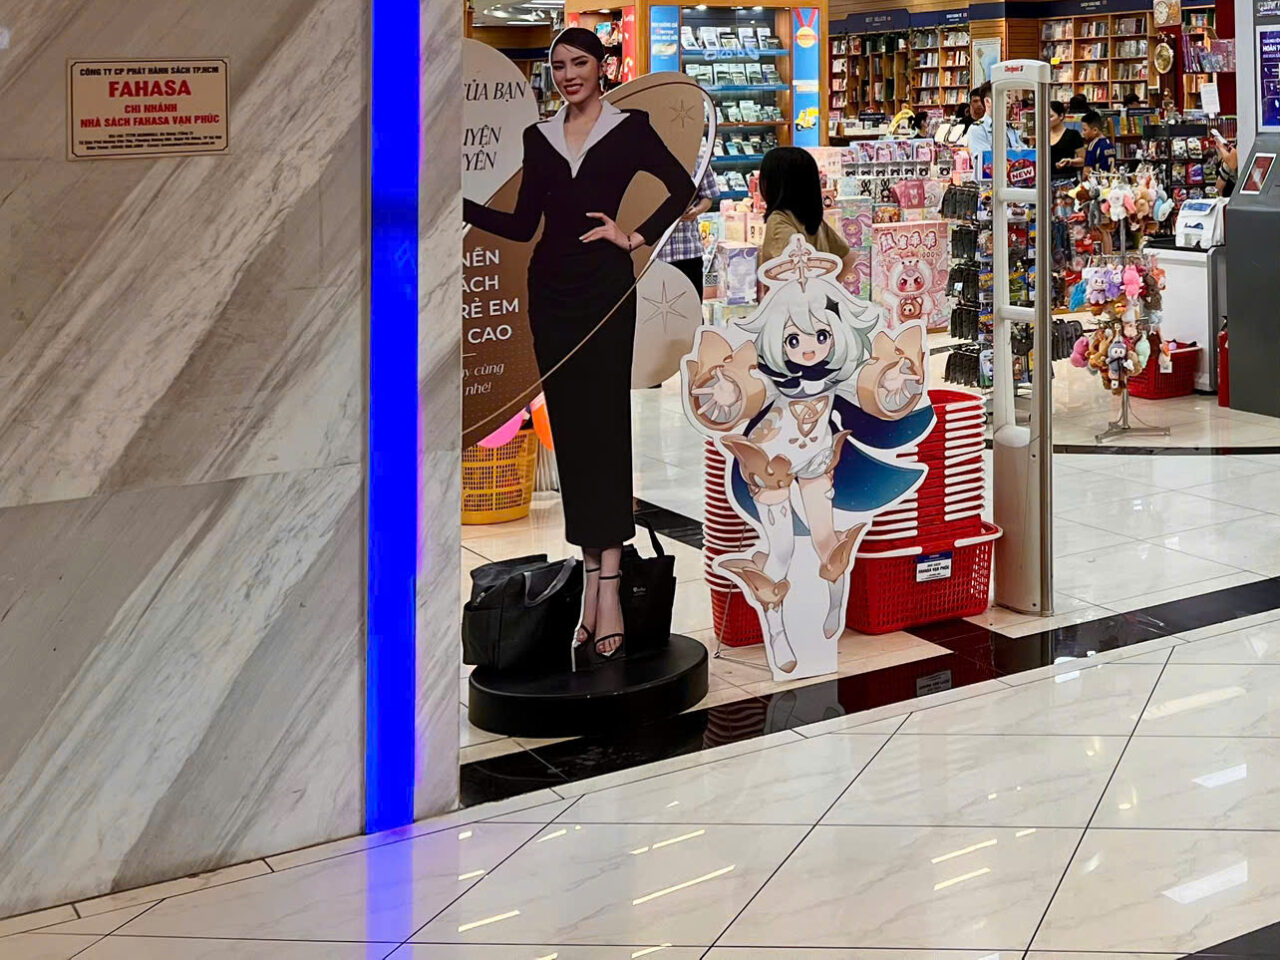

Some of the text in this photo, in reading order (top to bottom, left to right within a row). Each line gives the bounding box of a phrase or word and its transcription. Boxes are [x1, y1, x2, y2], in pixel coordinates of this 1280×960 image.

[80, 67, 101, 77] CÔNG
[103, 68, 112, 76] TY
[114, 68, 124, 76] CP
[126, 66, 146, 76] PHÁT
[171, 65, 190, 75] SÁCH
[109, 80, 192, 98] FAHASA
[464, 79, 527, 103] ỦA BẠN
[124, 102, 178, 114] CHI NHÁNH
[80, 113, 220, 128] NHÀ SÁCH FAHASA VẠN PHÚC
[1012, 168, 1033, 180] NEW
[489, 298, 519, 316] EM
[468, 324, 513, 344] CAO
[474, 363, 505, 377] cùng
[465, 381, 492, 396] nhé!
